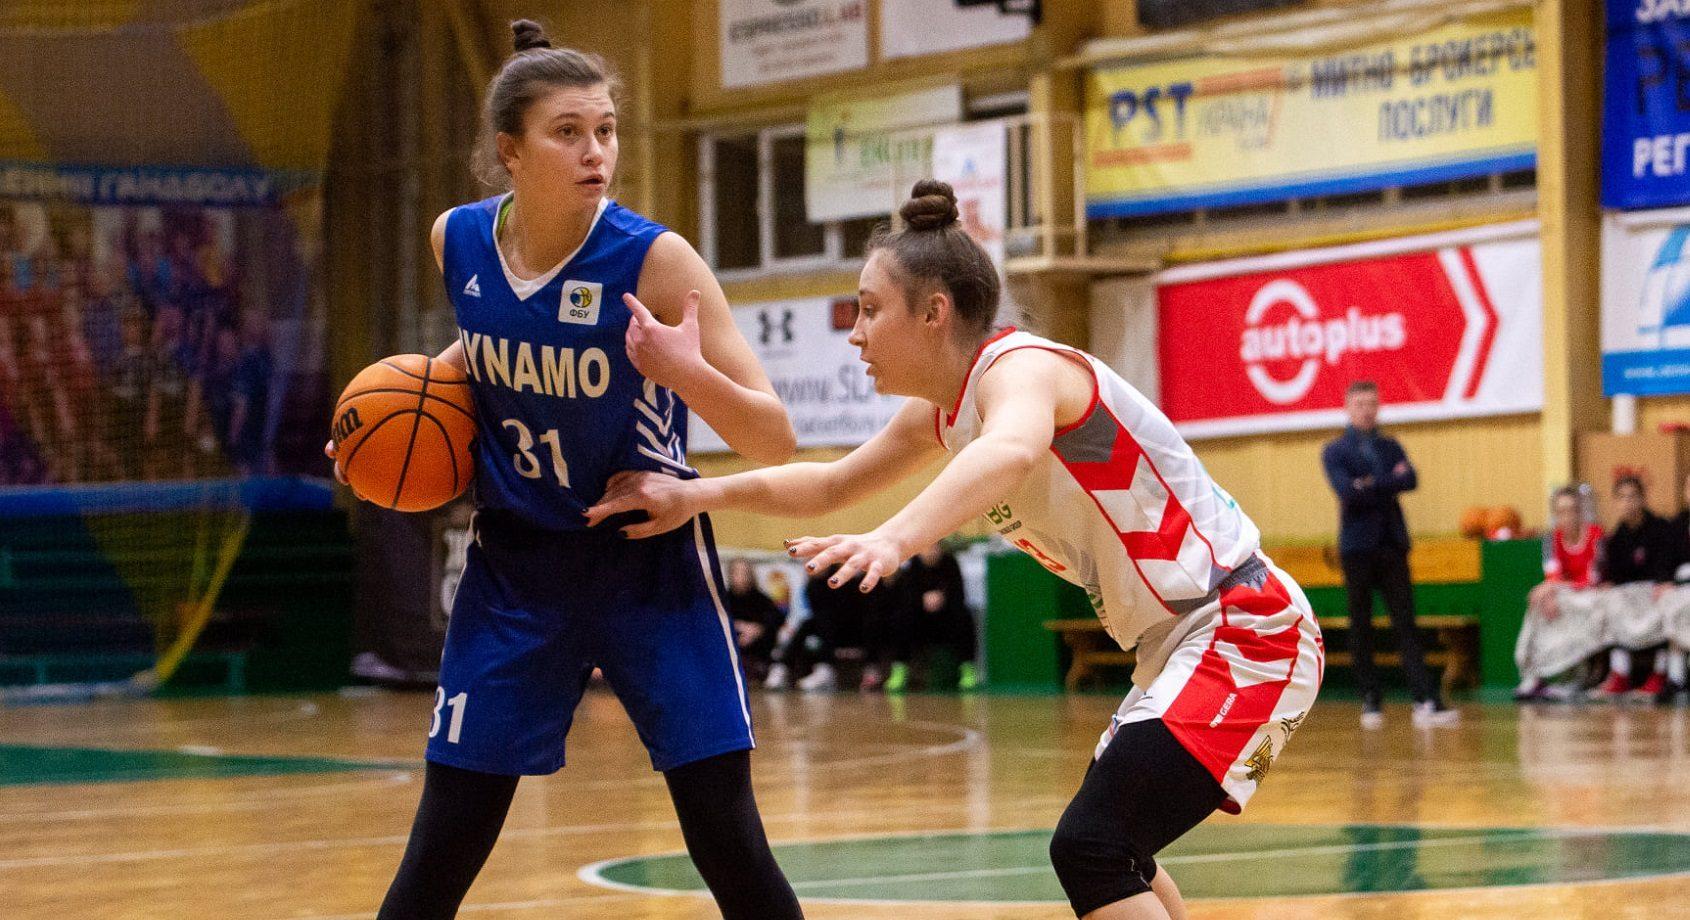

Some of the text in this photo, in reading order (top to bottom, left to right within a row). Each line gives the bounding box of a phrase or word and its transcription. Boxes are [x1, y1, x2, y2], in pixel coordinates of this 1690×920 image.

[1108, 81, 1194, 147] PST
[569, 308, 590, 319] ФБУ
[1240, 306, 1407, 364] autoplus
[461, 328, 611, 399] YNAMO
[502, 418, 572, 489] 31
